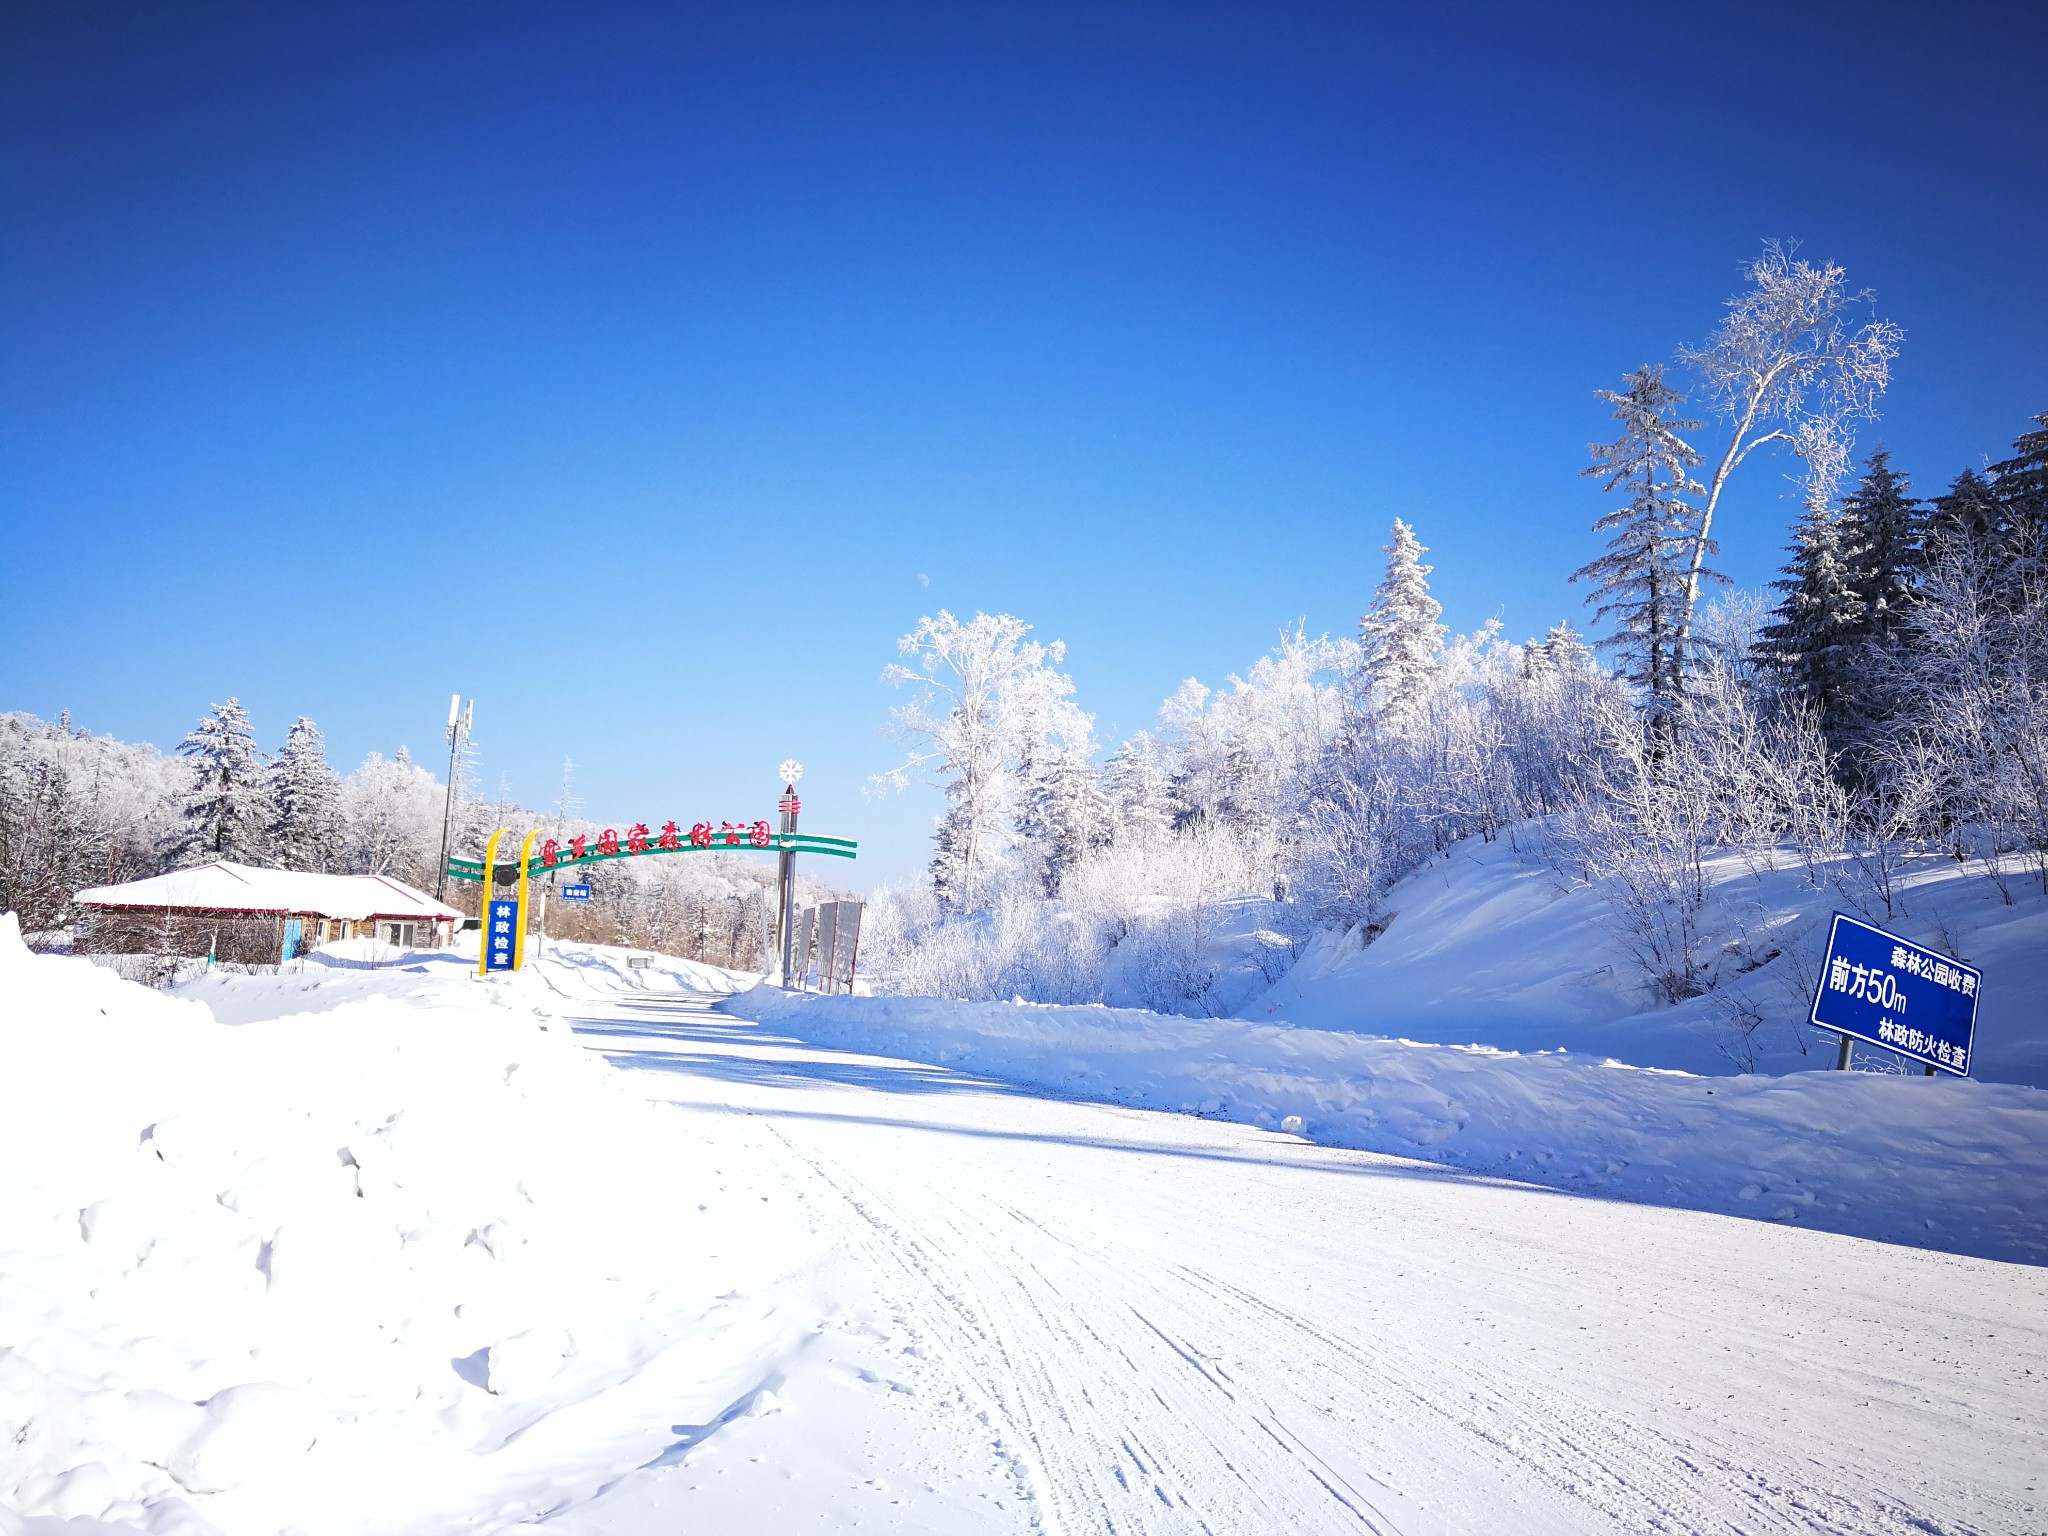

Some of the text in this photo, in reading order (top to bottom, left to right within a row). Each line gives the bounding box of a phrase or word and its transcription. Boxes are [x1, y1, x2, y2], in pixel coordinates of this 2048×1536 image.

[493, 905, 511, 965] 林政检查
[1829, 955, 1907, 1014] 前方50m
[1890, 945, 1976, 998] 森林公园收费
[1878, 1016, 1966, 1070] 林政防火检查
